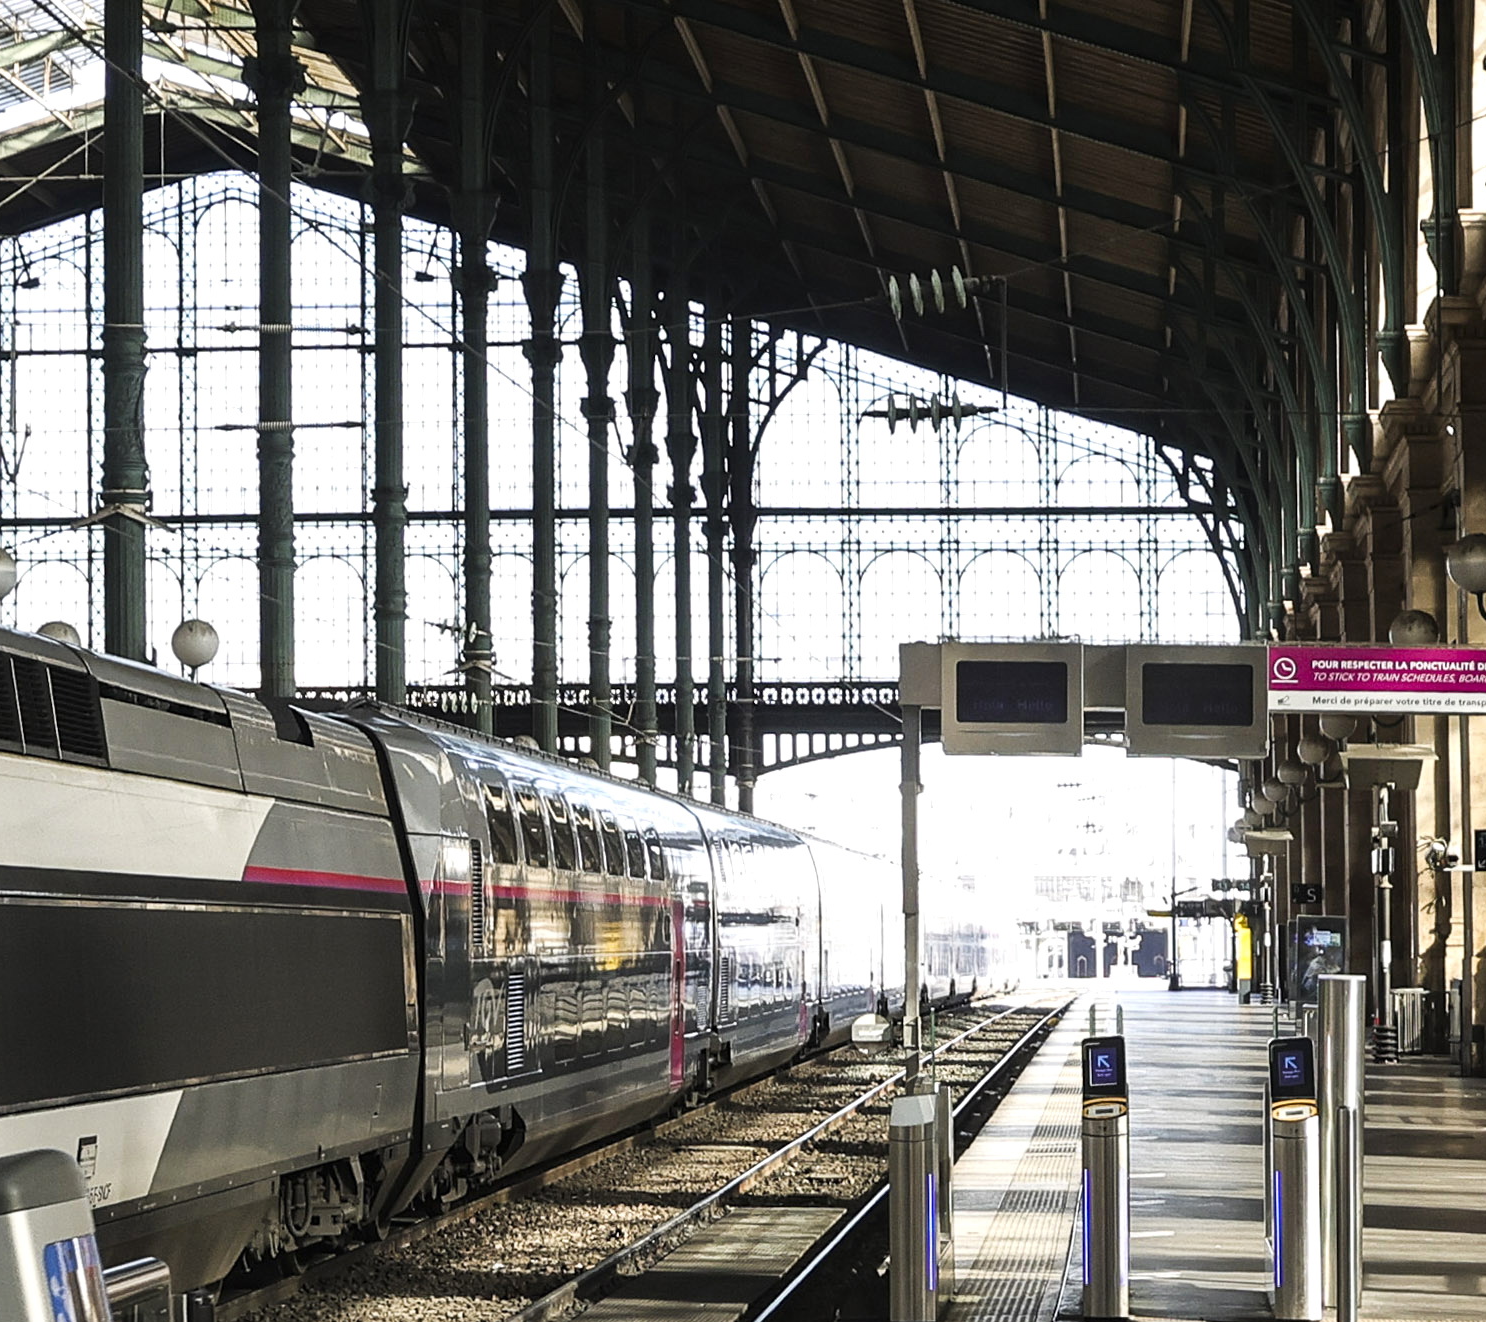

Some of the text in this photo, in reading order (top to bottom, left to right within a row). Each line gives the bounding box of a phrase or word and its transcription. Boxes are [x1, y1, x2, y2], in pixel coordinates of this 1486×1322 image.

[1312, 661, 1339, 669] POUR
[1341, 661, 1393, 669] RESPECTER
[1396, 661, 1408, 670] LA
[1410, 659, 1475, 671] PONCTUALITÉ
[1314, 673, 1326, 682] TO
[1328, 673, 1355, 682] STICK
[1357, 673, 1370, 682] TO
[1373, 674, 1399, 683] TRAIN
[1401, 674, 1456, 684] SCHEDULES,
[1313, 697, 1337, 705] Merci
[1340, 697, 1352, 705] de
[1354, 698, 1393, 707] préparer
[1396, 698, 1420, 706] votre
[1423, 698, 1441, 706] titre
[1307, 888, 1316, 902] S
